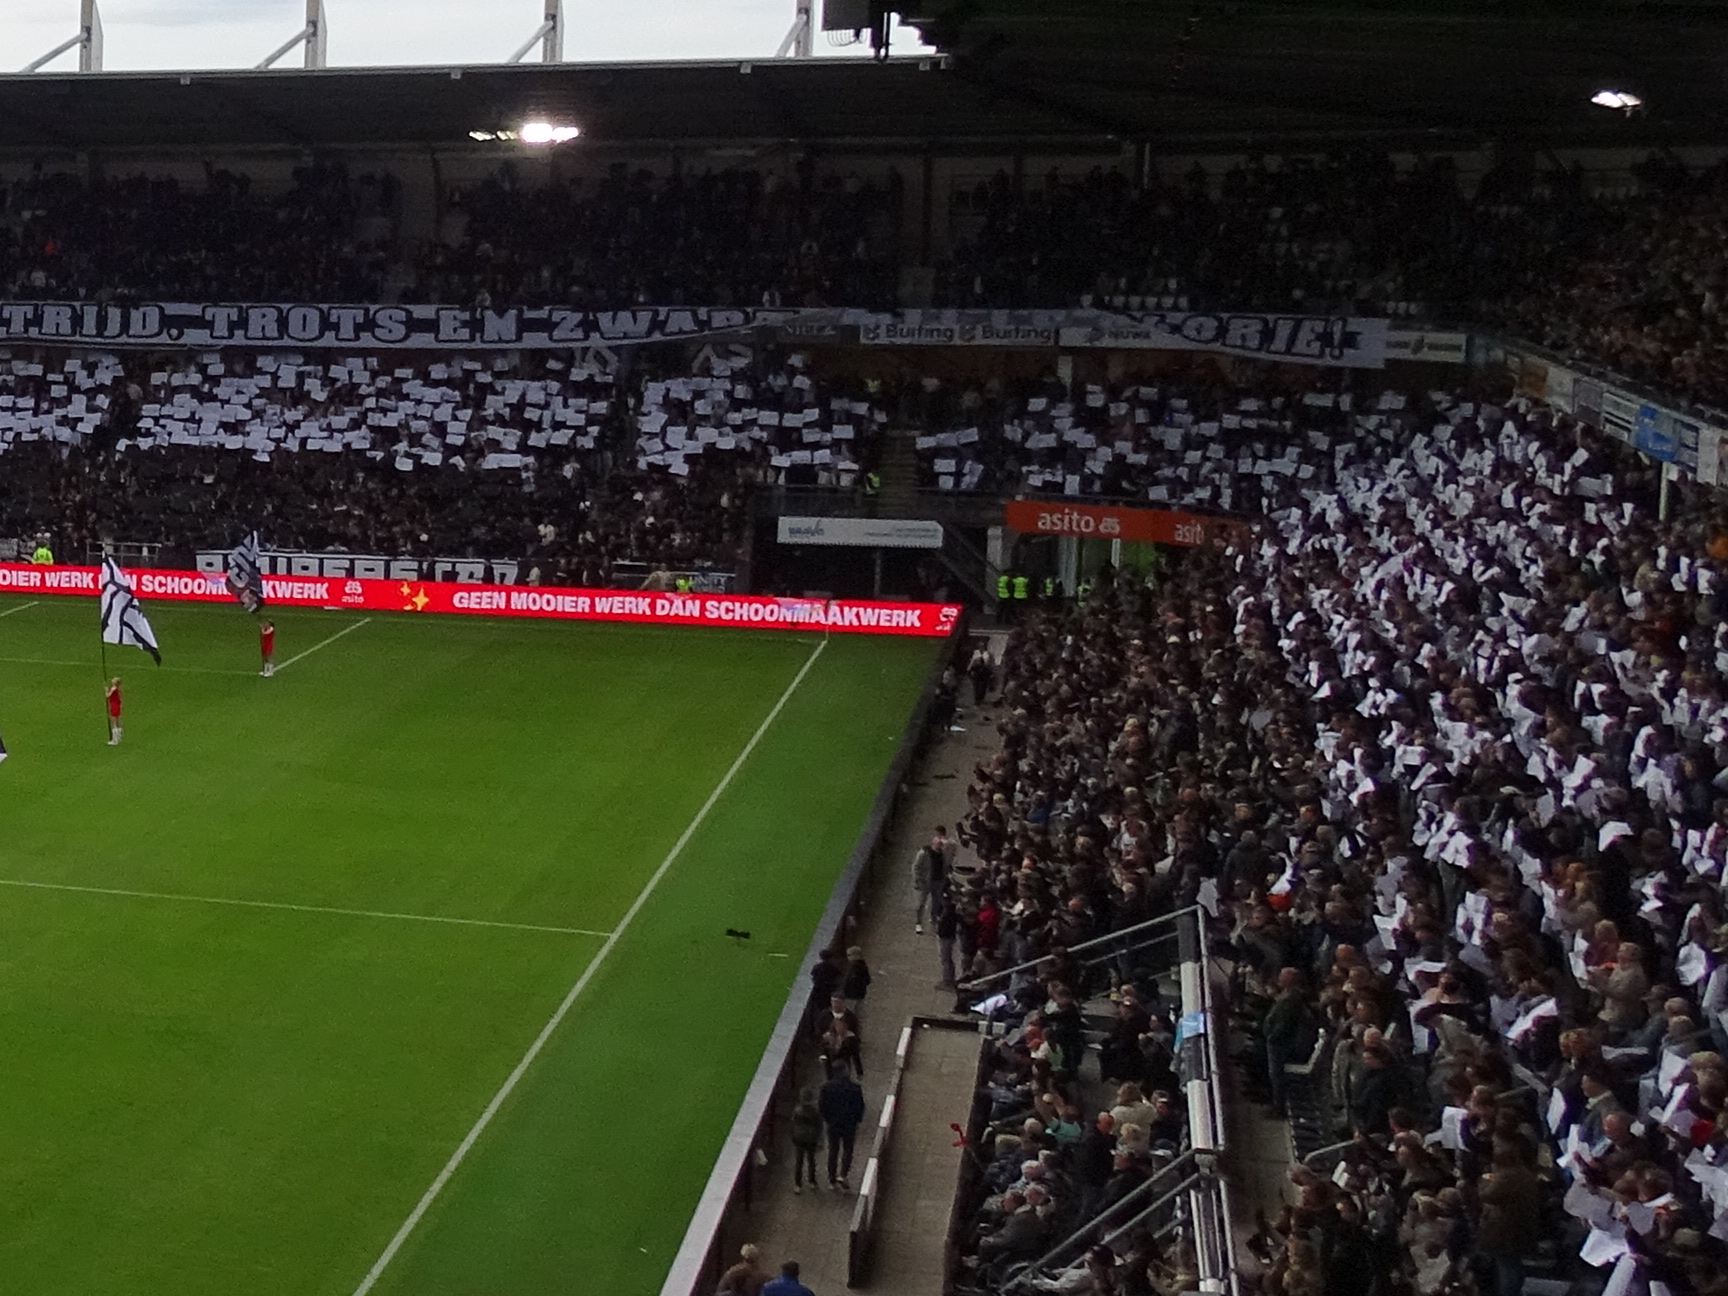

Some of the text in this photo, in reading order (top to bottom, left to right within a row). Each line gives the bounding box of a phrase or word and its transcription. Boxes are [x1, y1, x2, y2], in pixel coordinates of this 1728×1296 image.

[203, 305, 415, 342] TROTS
[1037, 507, 1095, 533] asito
[1174, 520, 1204, 543] asit
[45, 571, 94, 589] WERK
[453, 591, 506, 609] GEEN
[510, 592, 590, 613] MOOIER
[594, 596, 651, 615] WERK
[655, 599, 700, 617] DAN
